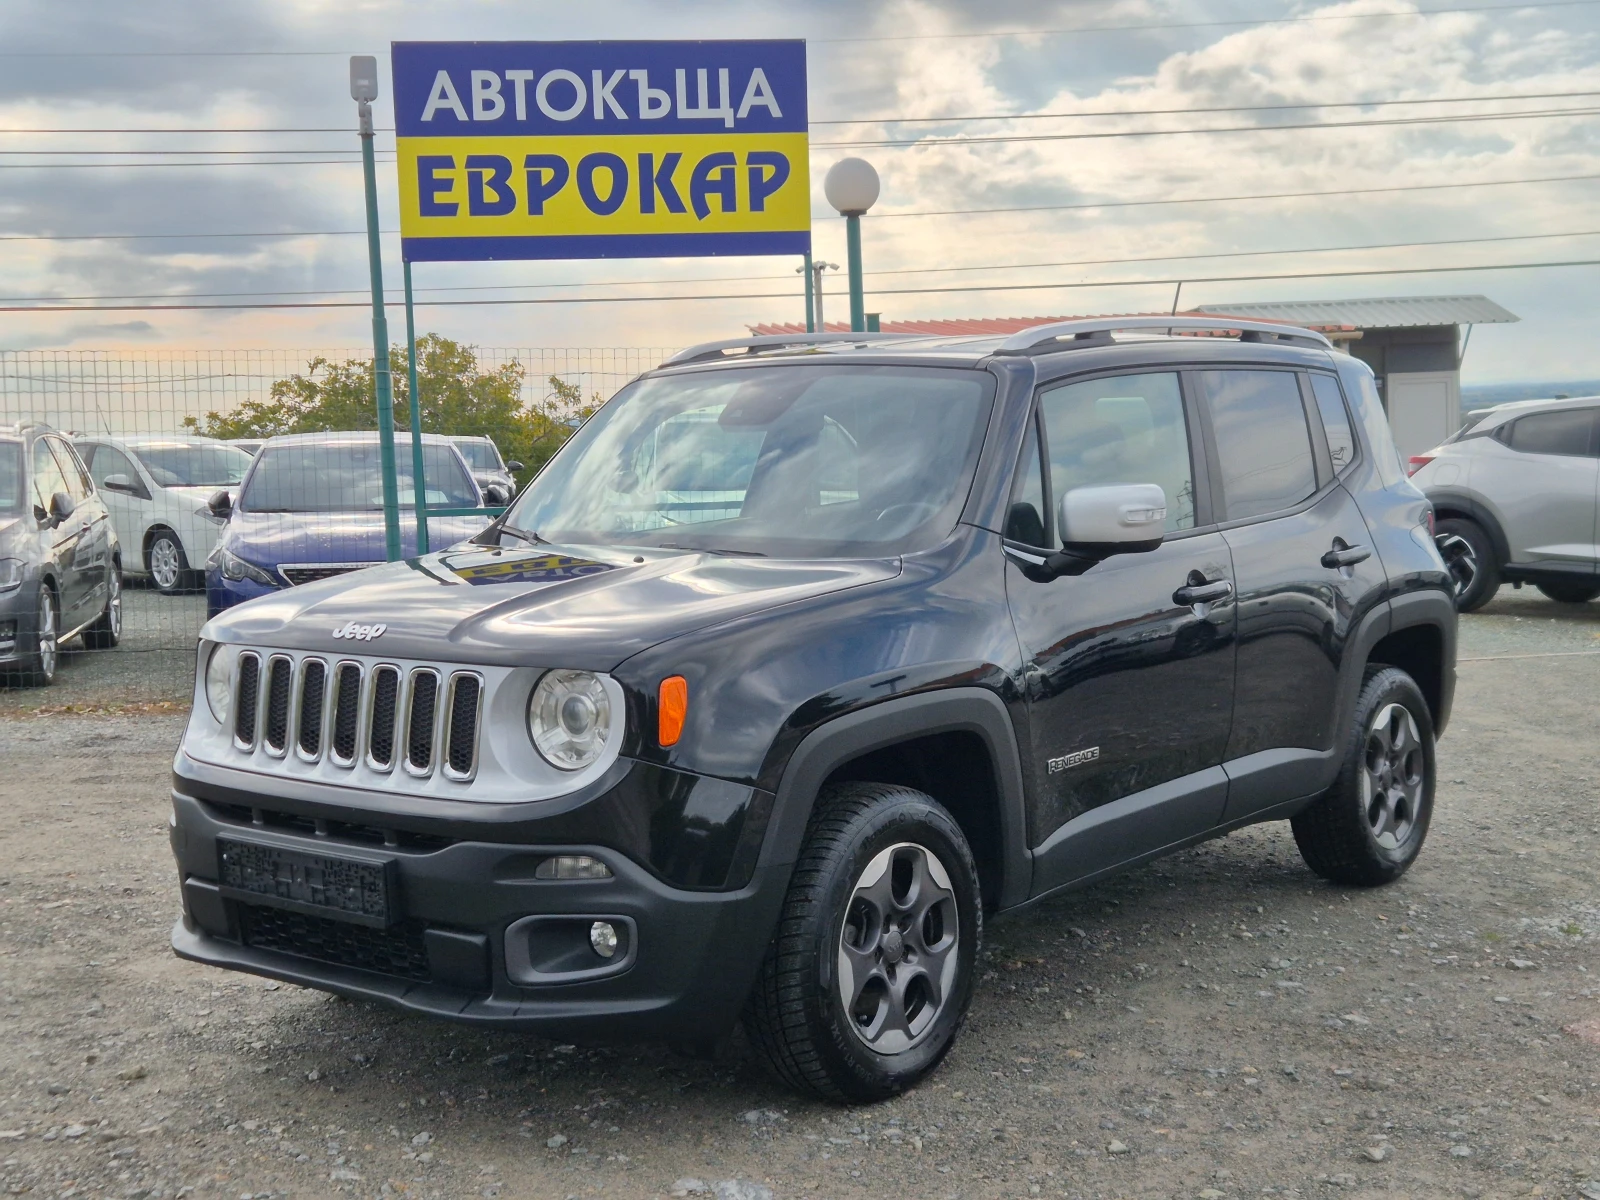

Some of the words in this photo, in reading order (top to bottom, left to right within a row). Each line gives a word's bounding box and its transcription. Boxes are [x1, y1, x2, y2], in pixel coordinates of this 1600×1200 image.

[420, 67, 783, 128] АВТОКЪЩА
[416, 151, 791, 222] ЕВРОКАР
[332, 621, 387, 642] Jeep
[1047, 746, 1100, 775] RENEGADE
